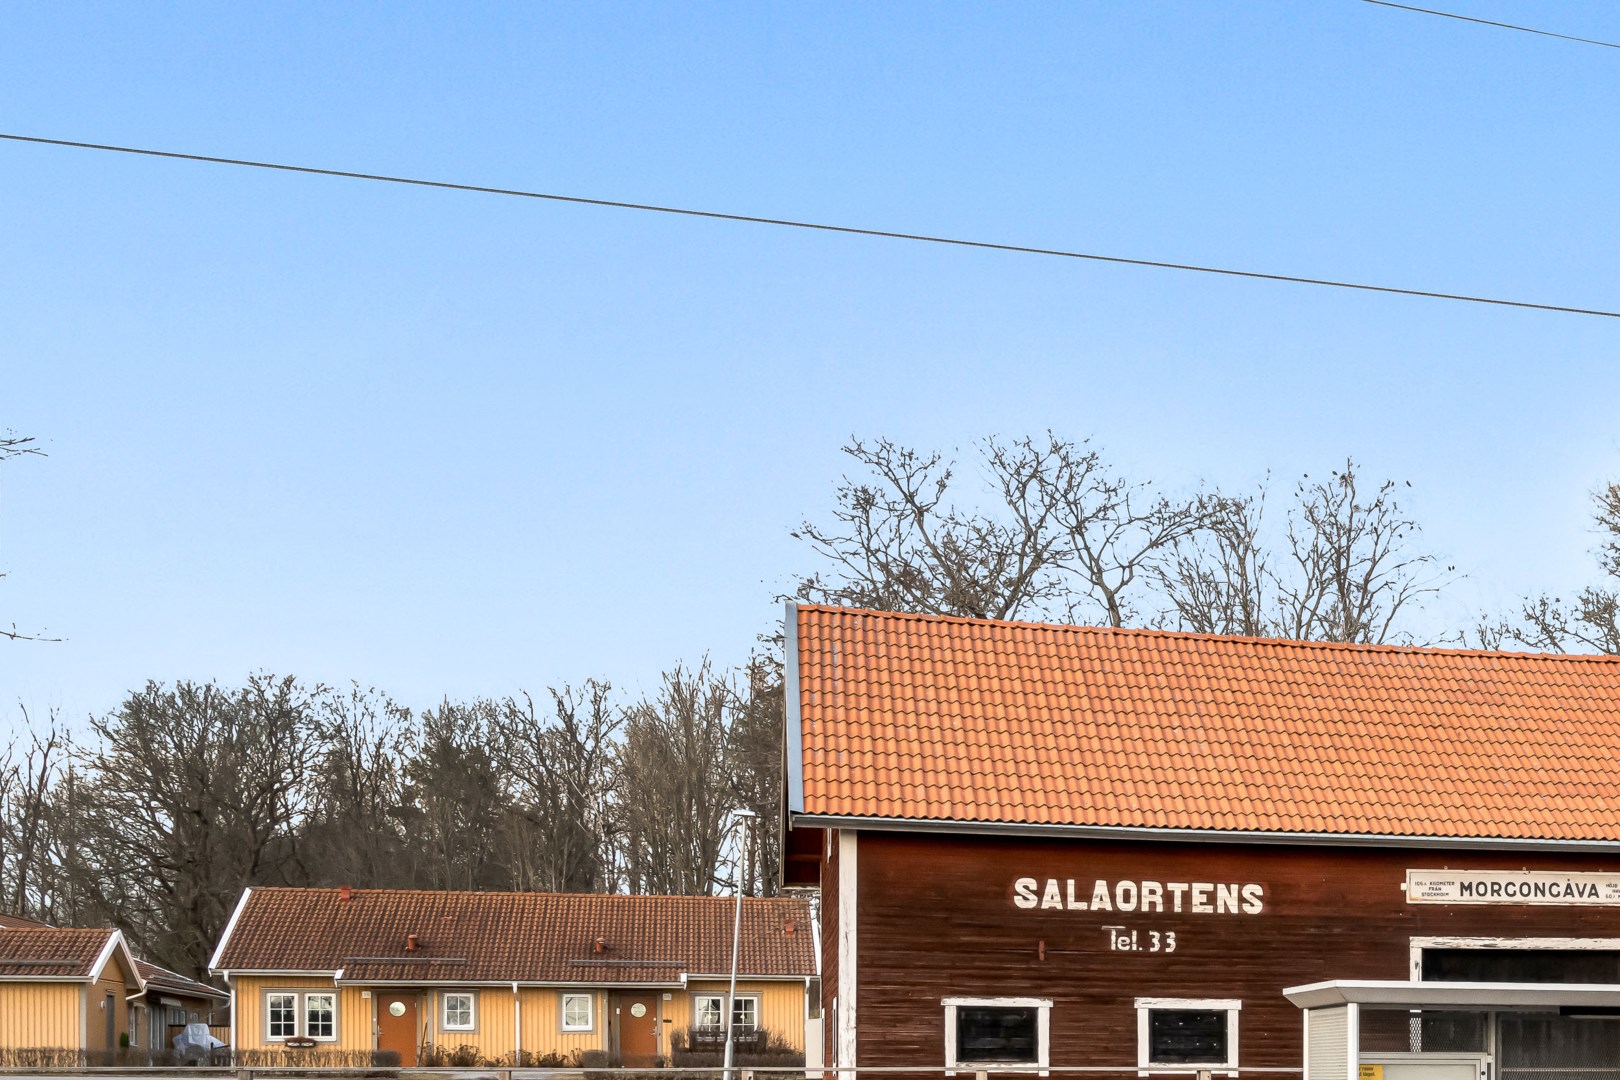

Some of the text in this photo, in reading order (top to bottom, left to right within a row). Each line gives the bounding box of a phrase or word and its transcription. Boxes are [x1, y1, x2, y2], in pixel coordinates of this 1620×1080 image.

[1013, 877, 1264, 915] SALAORTENS
[1460, 878, 1600, 899] MORGONGÅVA
[1101, 925, 1177, 953] Tel. 33
